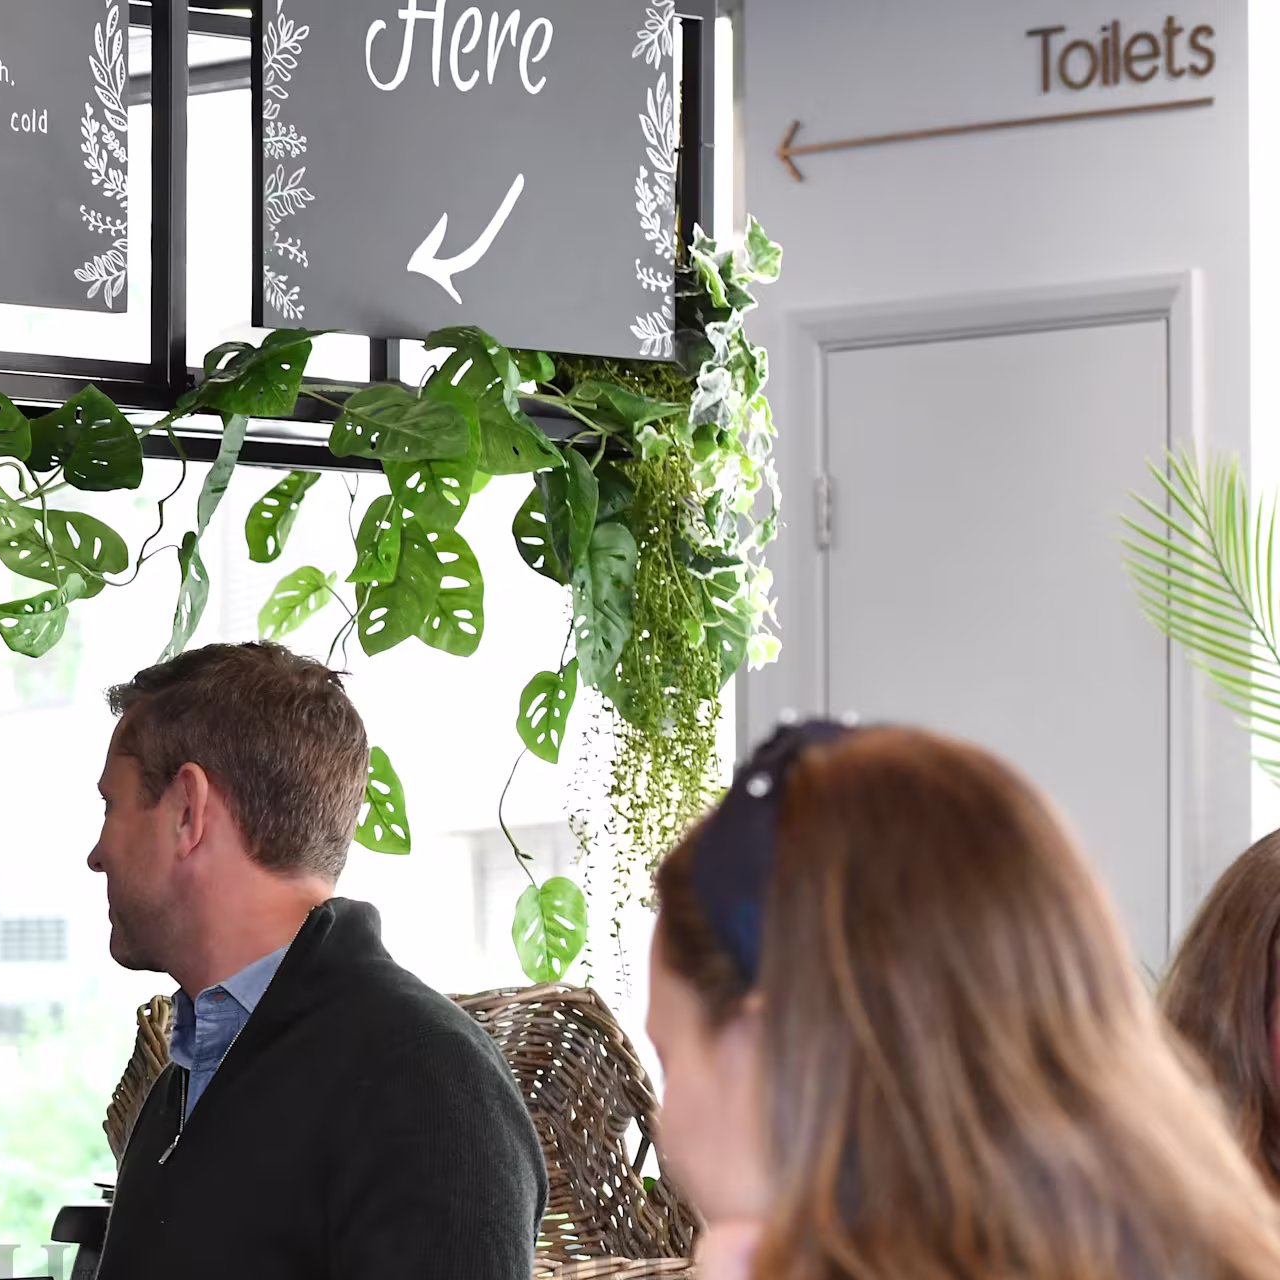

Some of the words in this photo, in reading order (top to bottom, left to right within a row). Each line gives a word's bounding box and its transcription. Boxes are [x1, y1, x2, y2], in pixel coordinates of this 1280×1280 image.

[365, 0, 554, 95] Here
[1026, 15, 1217, 93] Toilets
[10, 109, 49, 135] cold
